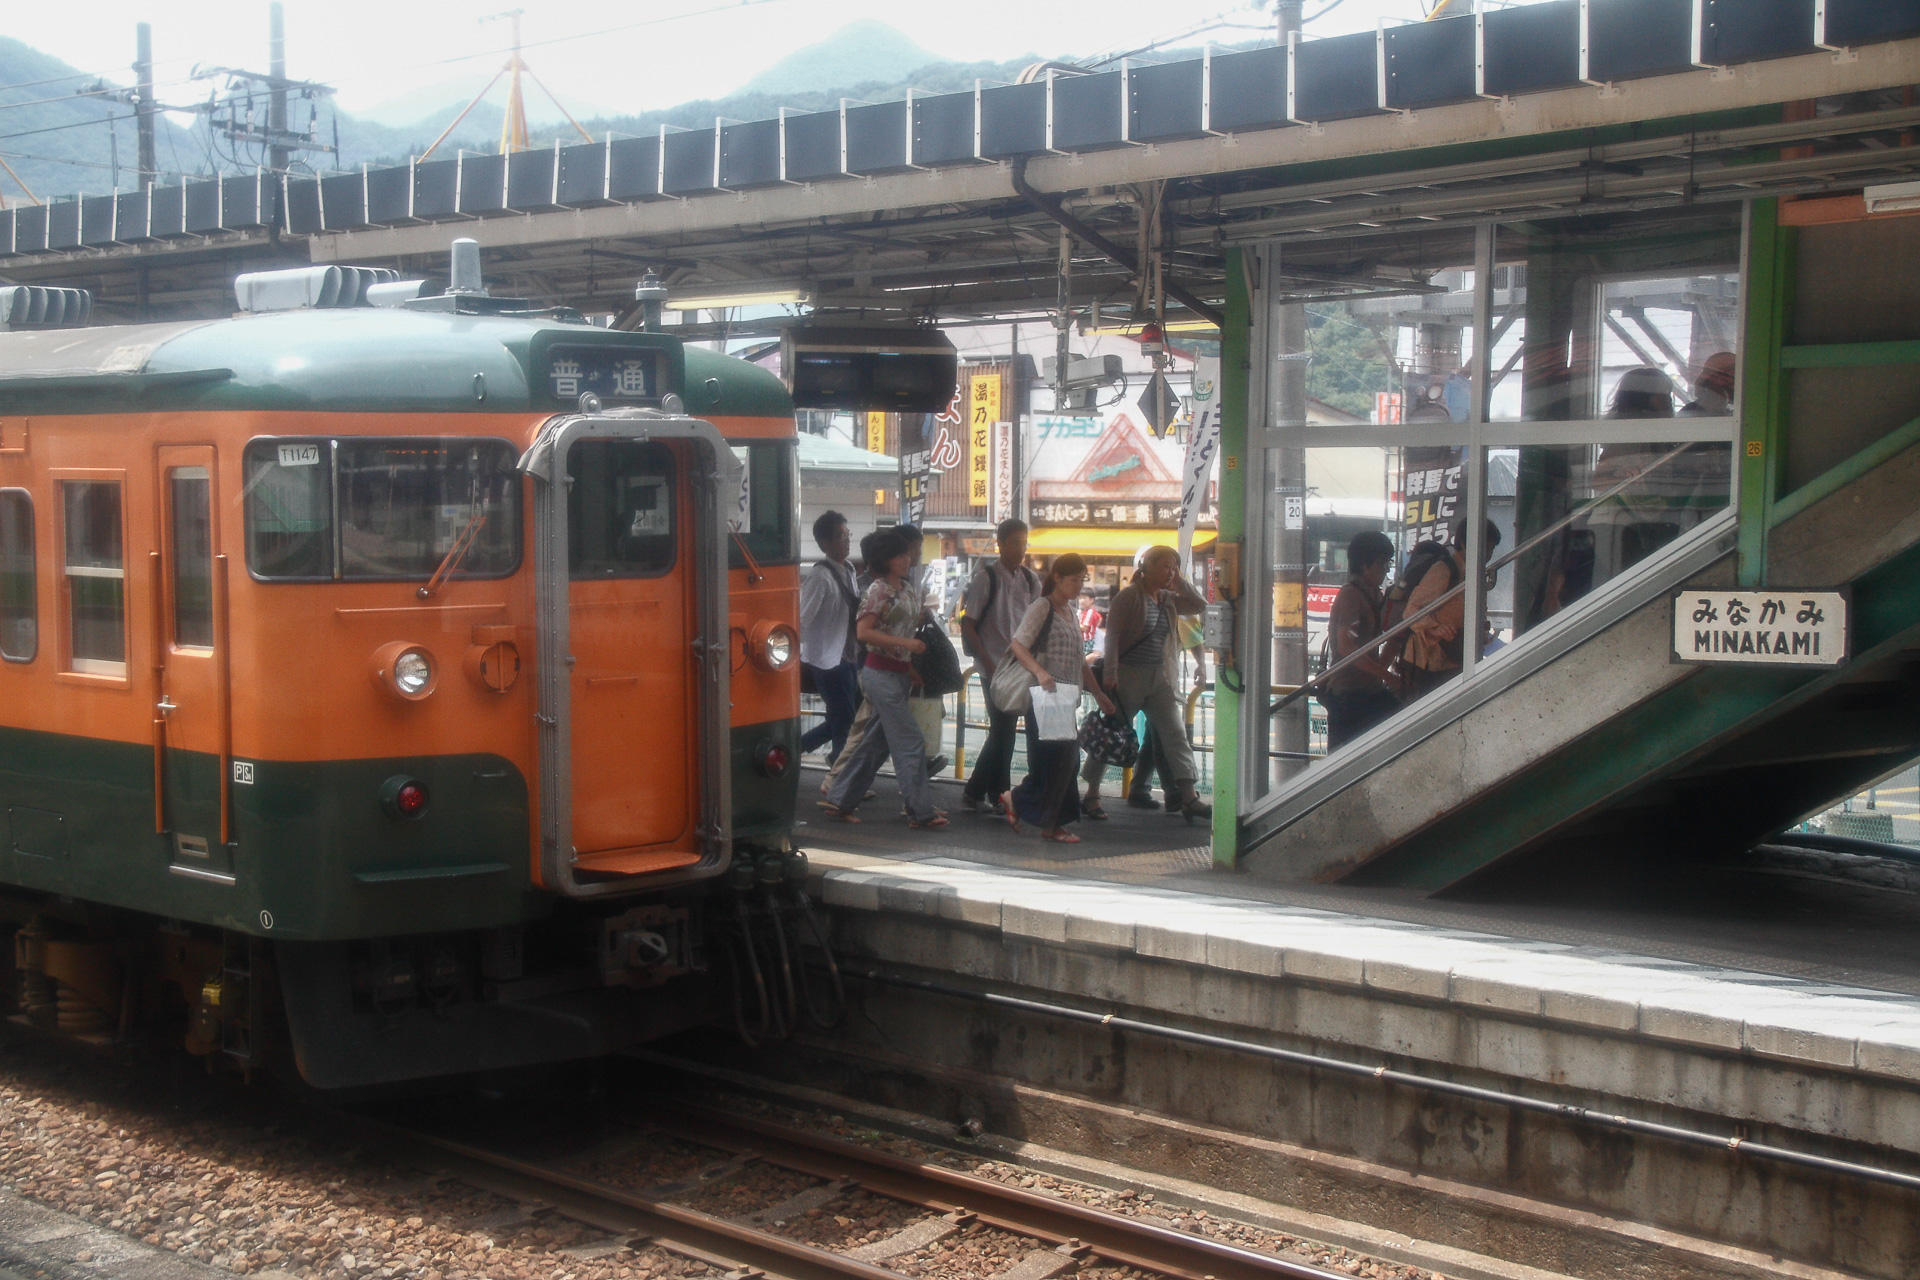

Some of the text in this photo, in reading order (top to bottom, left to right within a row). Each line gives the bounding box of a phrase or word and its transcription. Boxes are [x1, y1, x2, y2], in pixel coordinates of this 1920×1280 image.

[550, 359, 646, 395] 普通
[281, 447, 317, 462] T1147
[1406, 466, 1461, 497] 群馬で
[1045, 504, 1088, 522] まんじゅう
[1289, 506, 1301, 518] 20
[1406, 496, 1457, 525] SLに
[1693, 598, 1825, 627] みなかみ
[1694, 629, 1820, 656] MINAKAMI
